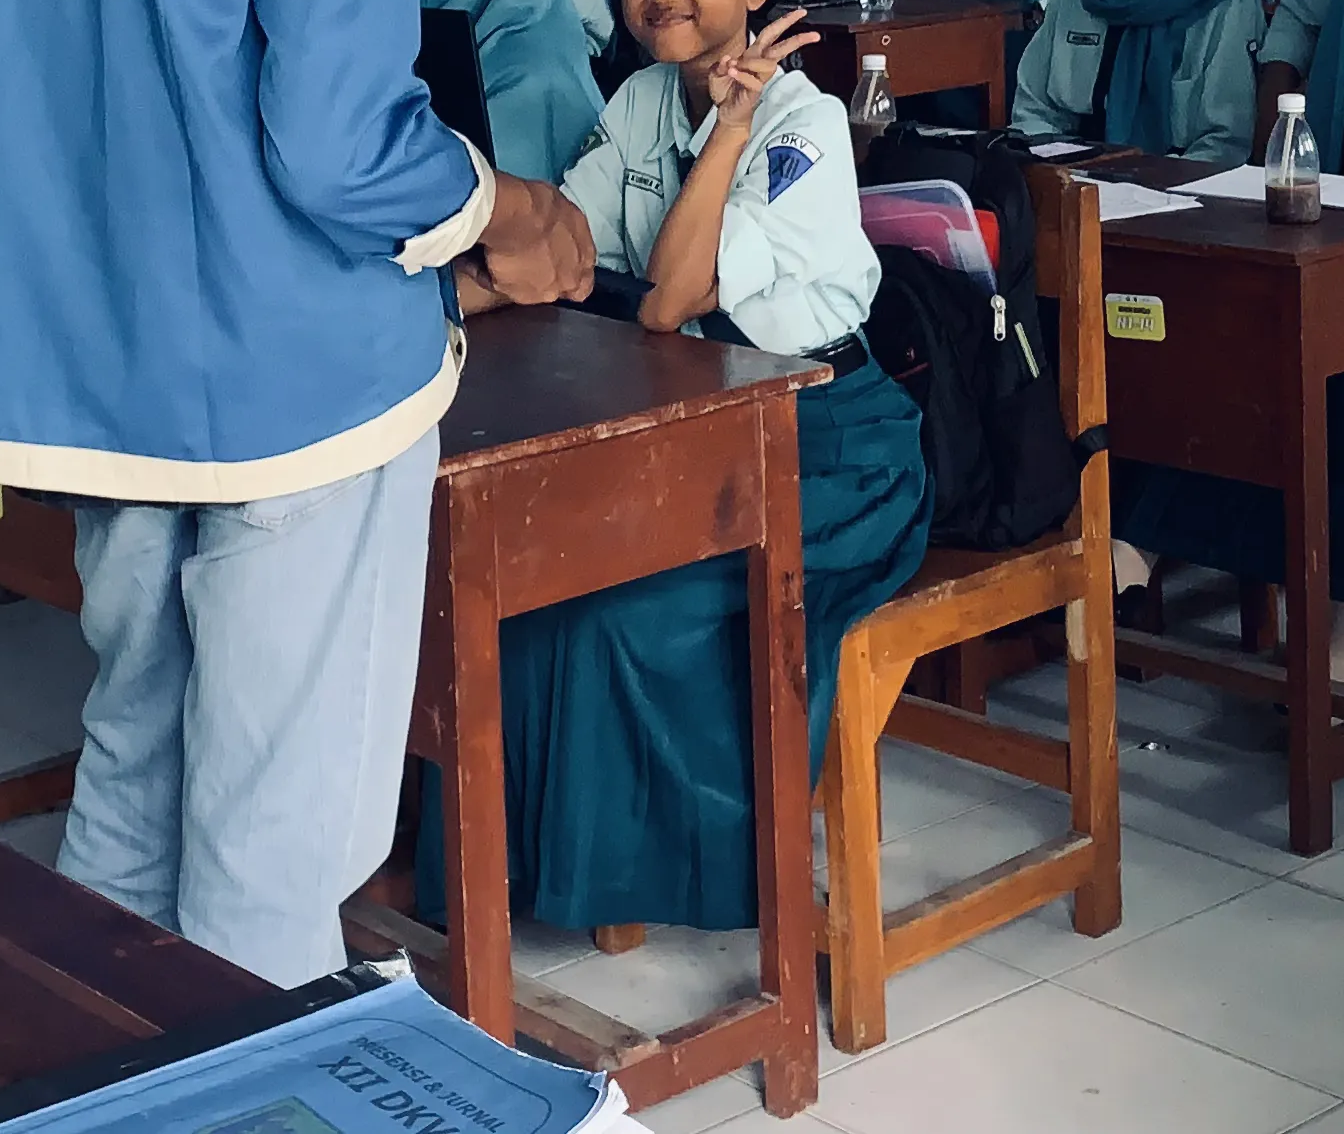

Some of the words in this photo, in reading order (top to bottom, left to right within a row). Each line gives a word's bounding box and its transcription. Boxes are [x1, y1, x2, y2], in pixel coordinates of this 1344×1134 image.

[771, 154, 800, 181] XII
[780, 133, 808, 149] DKV
[316, 1054, 391, 1093] XII
[369, 1089, 460, 1134] DKV
[349, 1036, 432, 1084] PRESENSI
[423, 1081, 444, 1094] &
[437, 1090, 506, 1134] JURNAL
